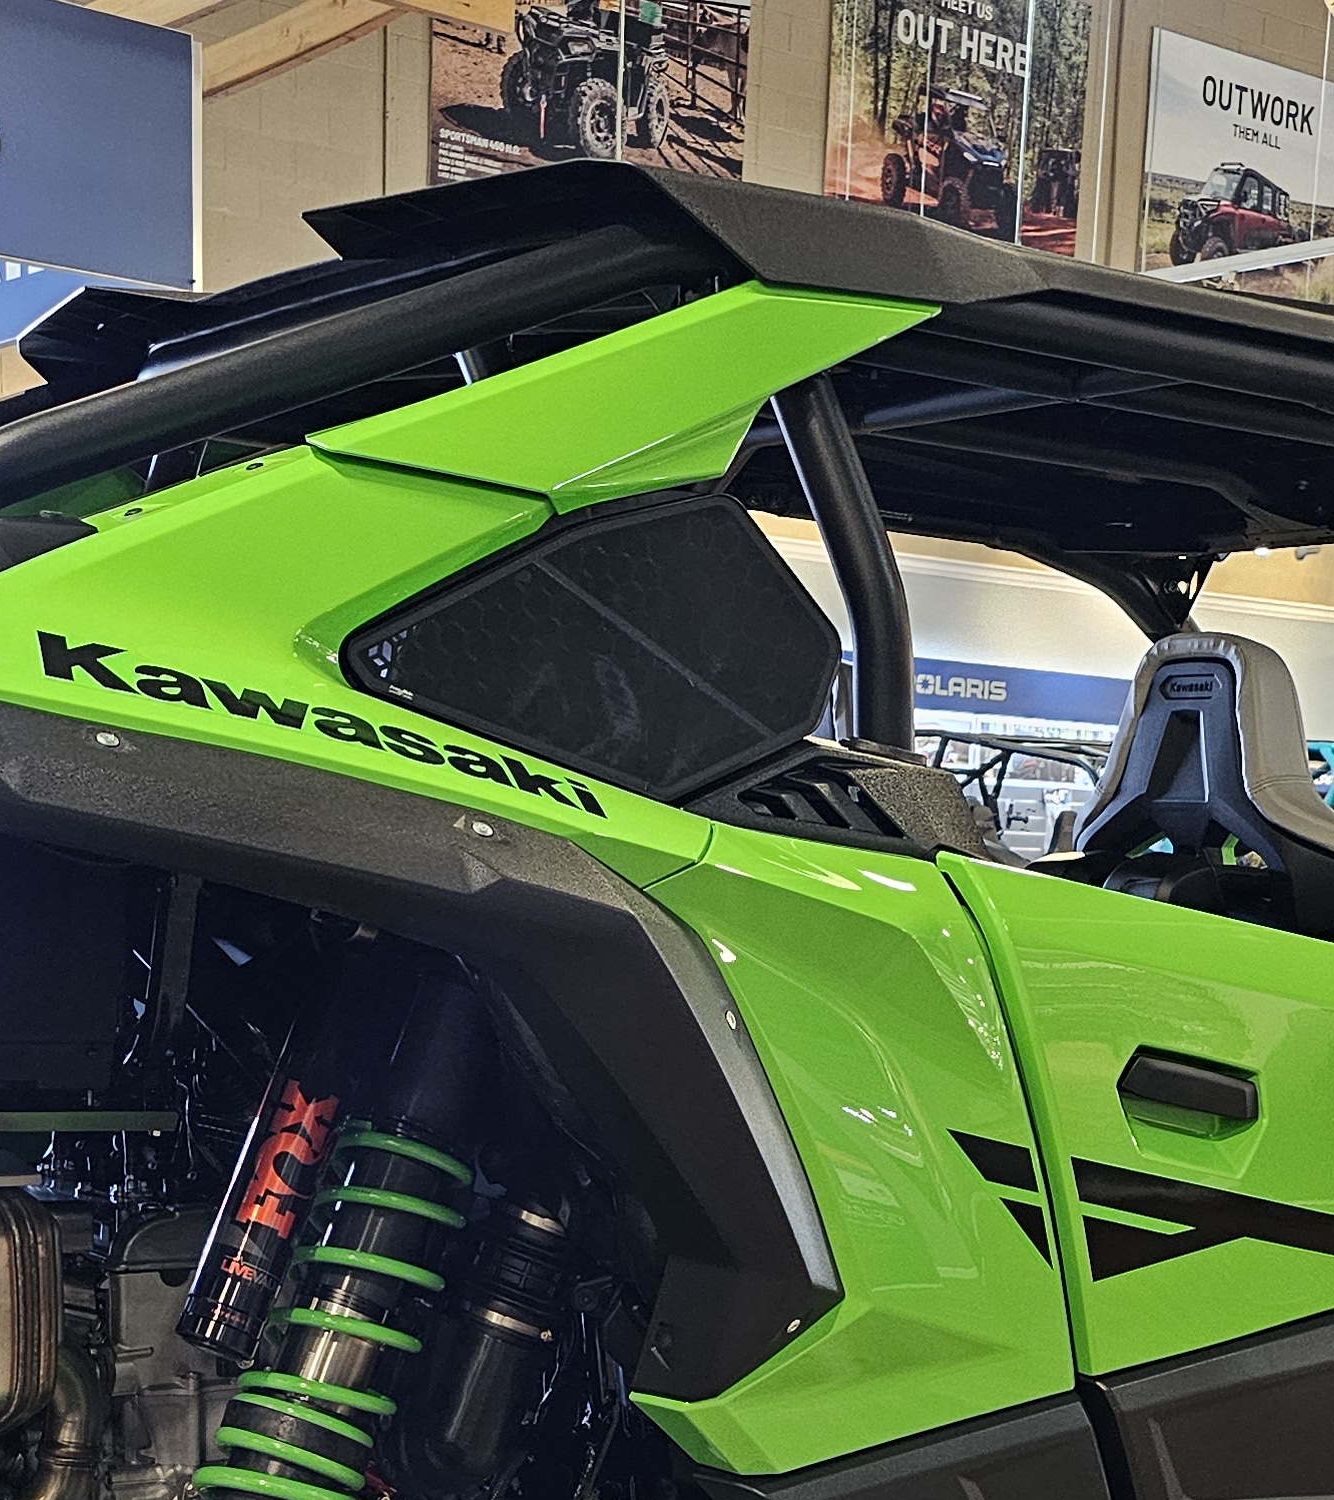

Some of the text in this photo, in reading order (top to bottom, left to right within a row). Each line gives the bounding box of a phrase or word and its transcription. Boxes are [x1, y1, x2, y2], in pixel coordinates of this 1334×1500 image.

[976, 3, 994, 21] US
[897, 9, 1032, 78] OUT HERE
[1203, 75, 1315, 136] OUTWORK
[439, 128, 489, 148] SPORTSMAN
[1233, 123, 1281, 150] THEM ALL
[914, 673, 1008, 701] OLARIS
[1169, 681, 1213, 693] Kawasaki
[37, 630, 608, 819] Kawasaki
[236, 1079, 340, 1239] FOX
